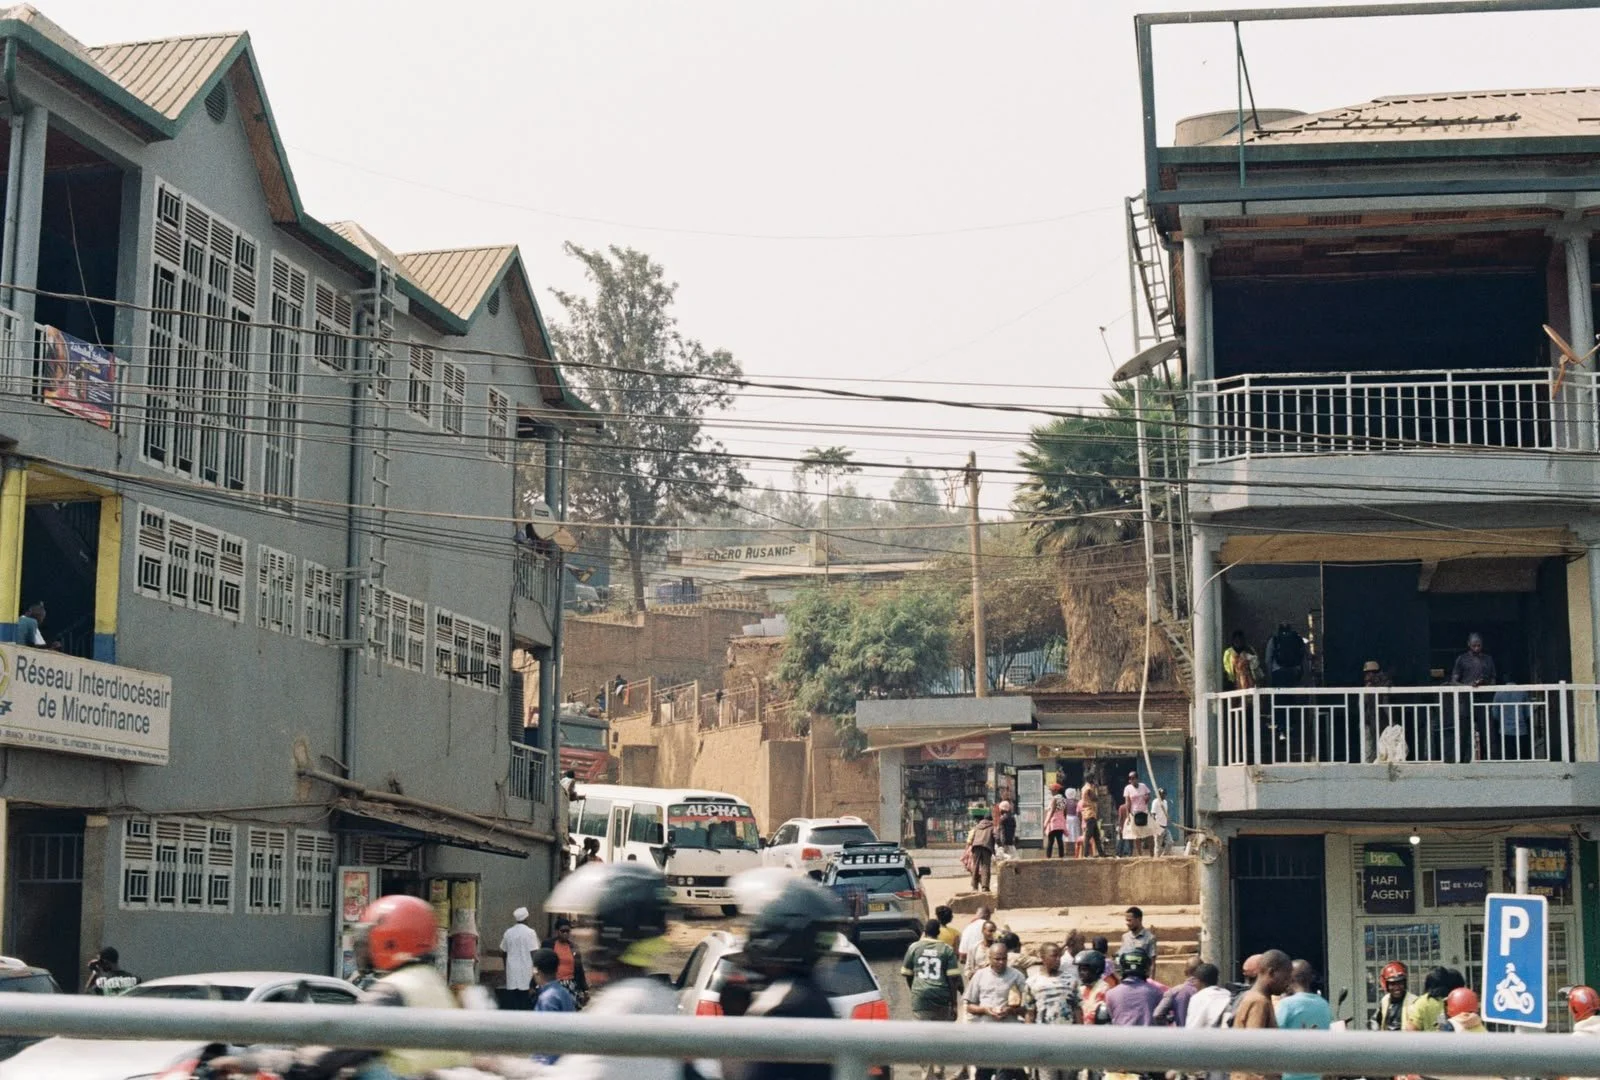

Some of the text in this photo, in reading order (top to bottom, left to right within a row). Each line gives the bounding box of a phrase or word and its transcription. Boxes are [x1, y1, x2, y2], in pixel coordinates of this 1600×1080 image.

[15, 655, 170, 709] Réseau Interdiocésair
[38, 692, 150, 734] de Microfinance
[686, 804, 740, 817] ALPHA
[1370, 852, 1389, 866] bpr
[1370, 875, 1397, 885] HAFI
[1371, 889, 1410, 899] AGENT
[1500, 905, 1530, 956] P
[917, 956, 942, 980] 33
